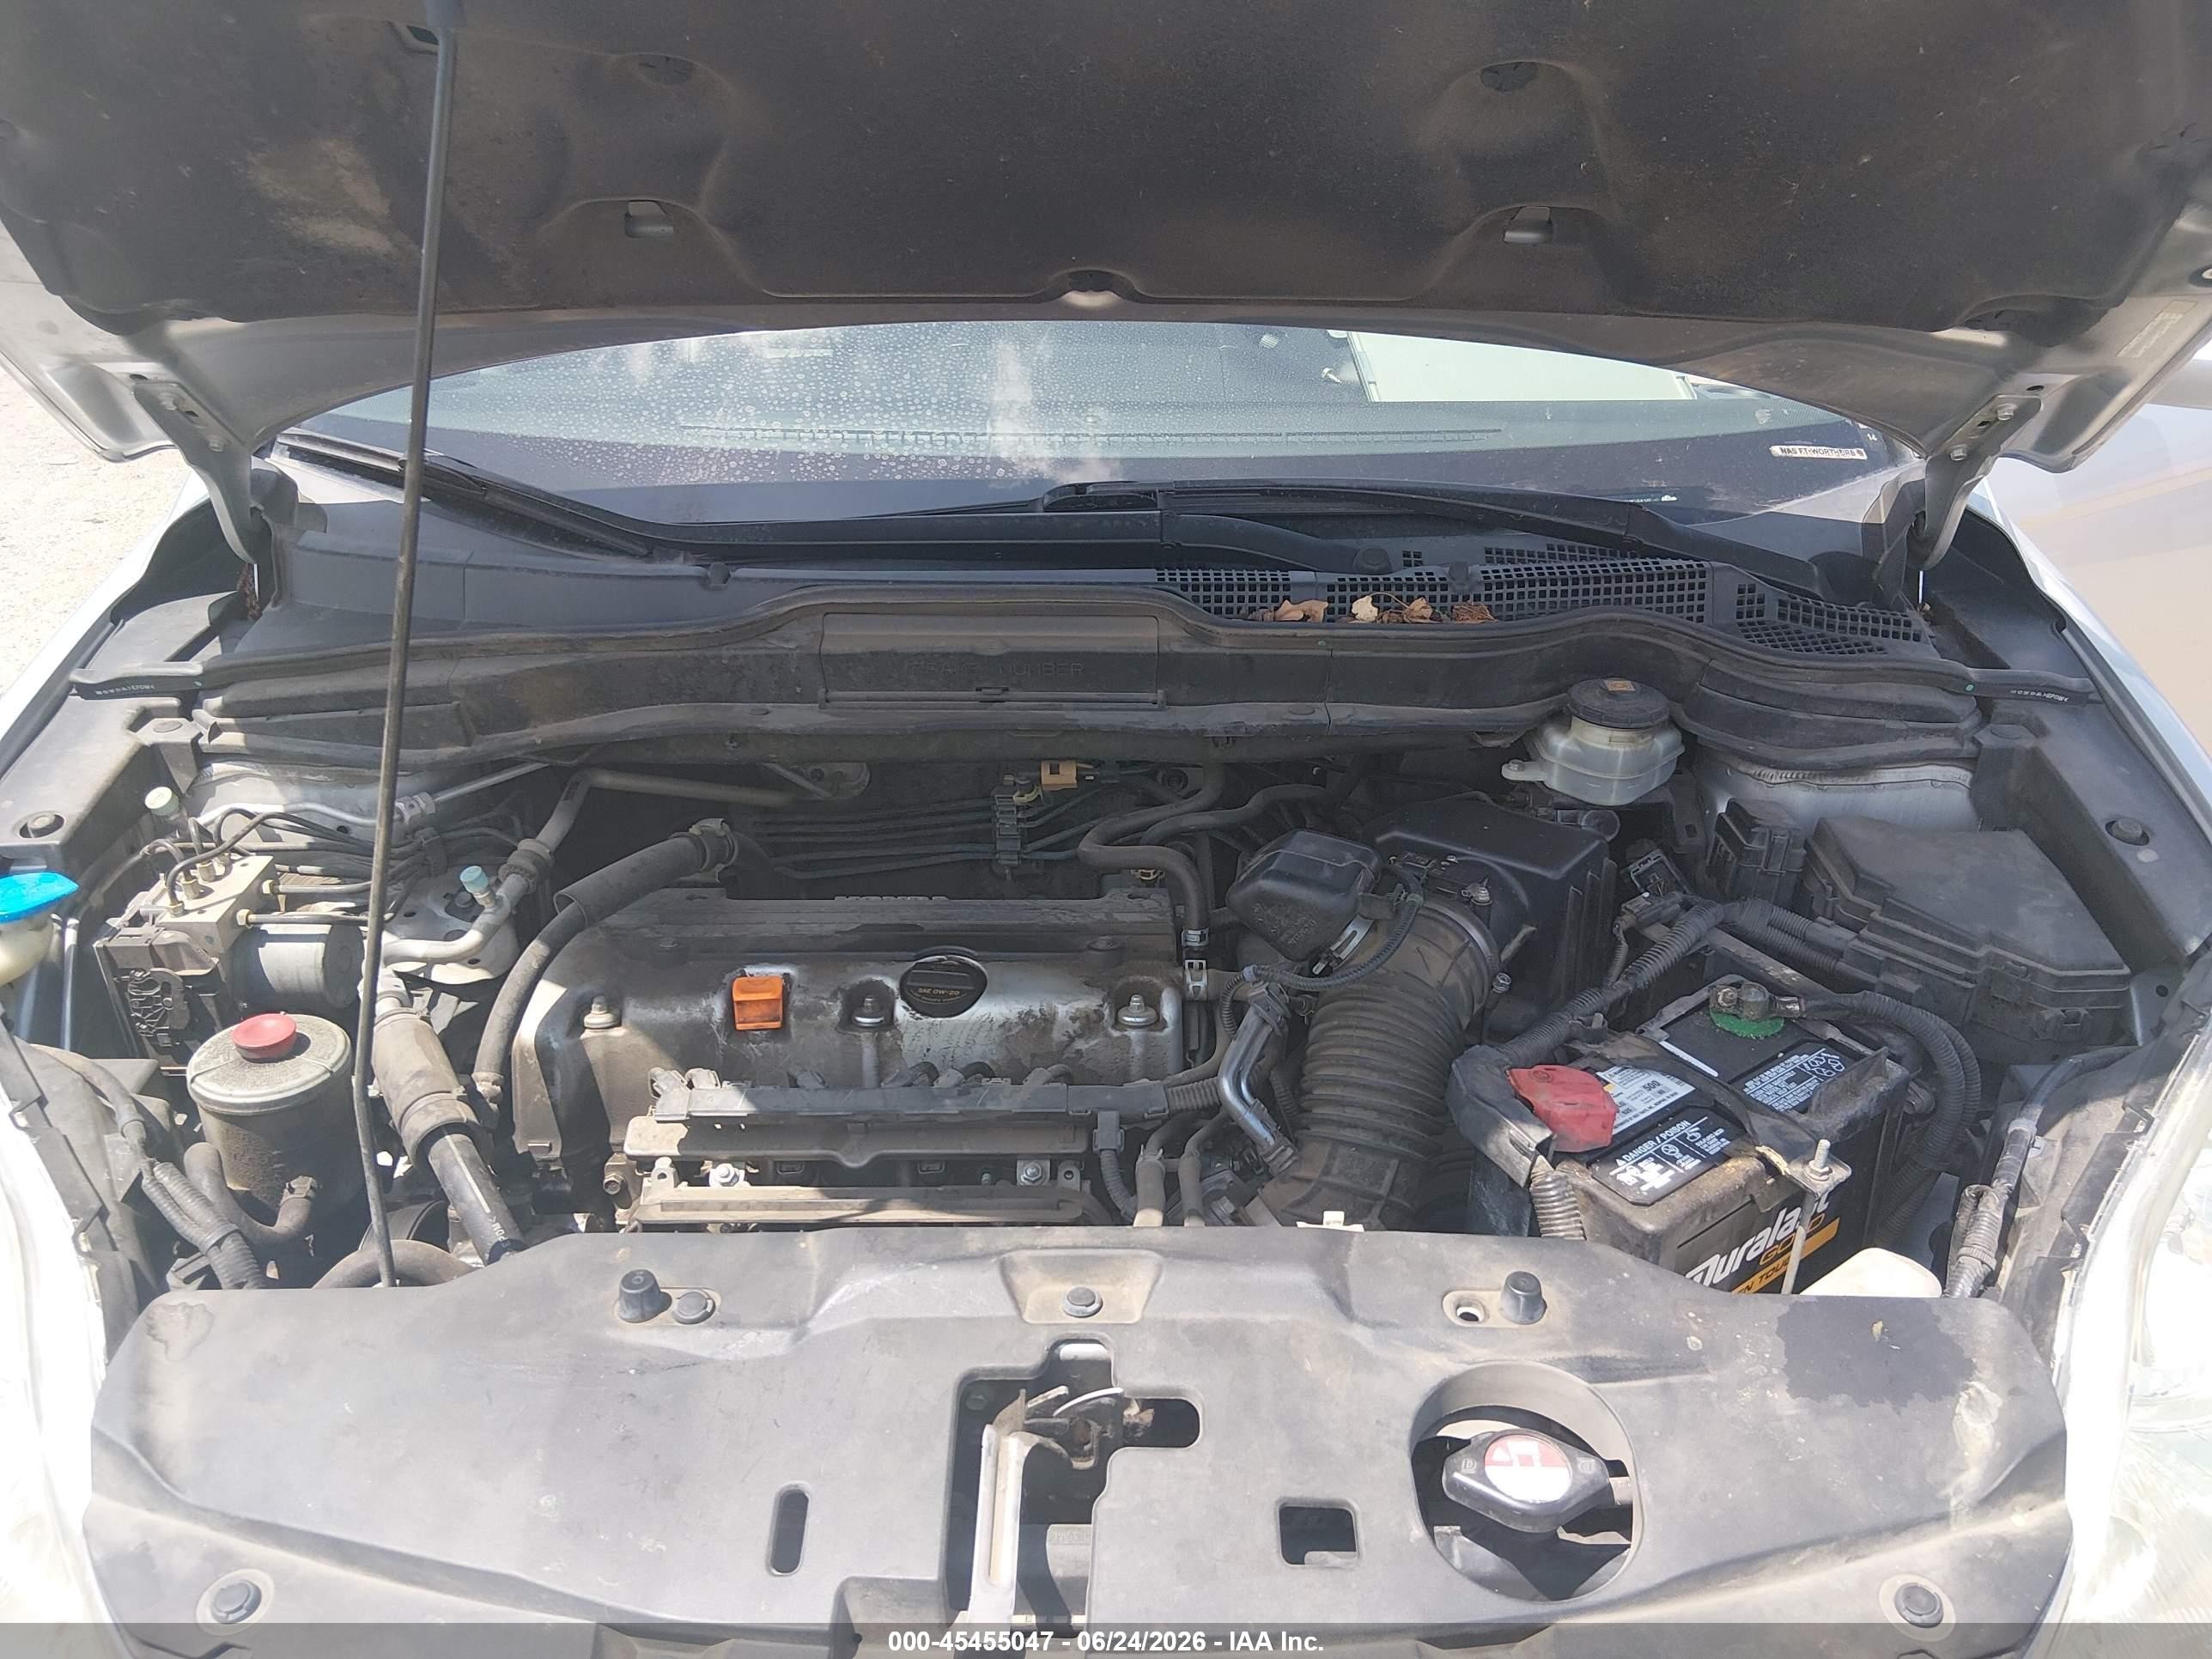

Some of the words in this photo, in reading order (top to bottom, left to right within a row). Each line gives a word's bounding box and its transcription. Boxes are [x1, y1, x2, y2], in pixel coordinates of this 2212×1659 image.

[996, 661, 1085, 677] NUMBER
[1642, 1080, 1662, 1091] 500
[1622, 1139, 1656, 1162] DANGER
